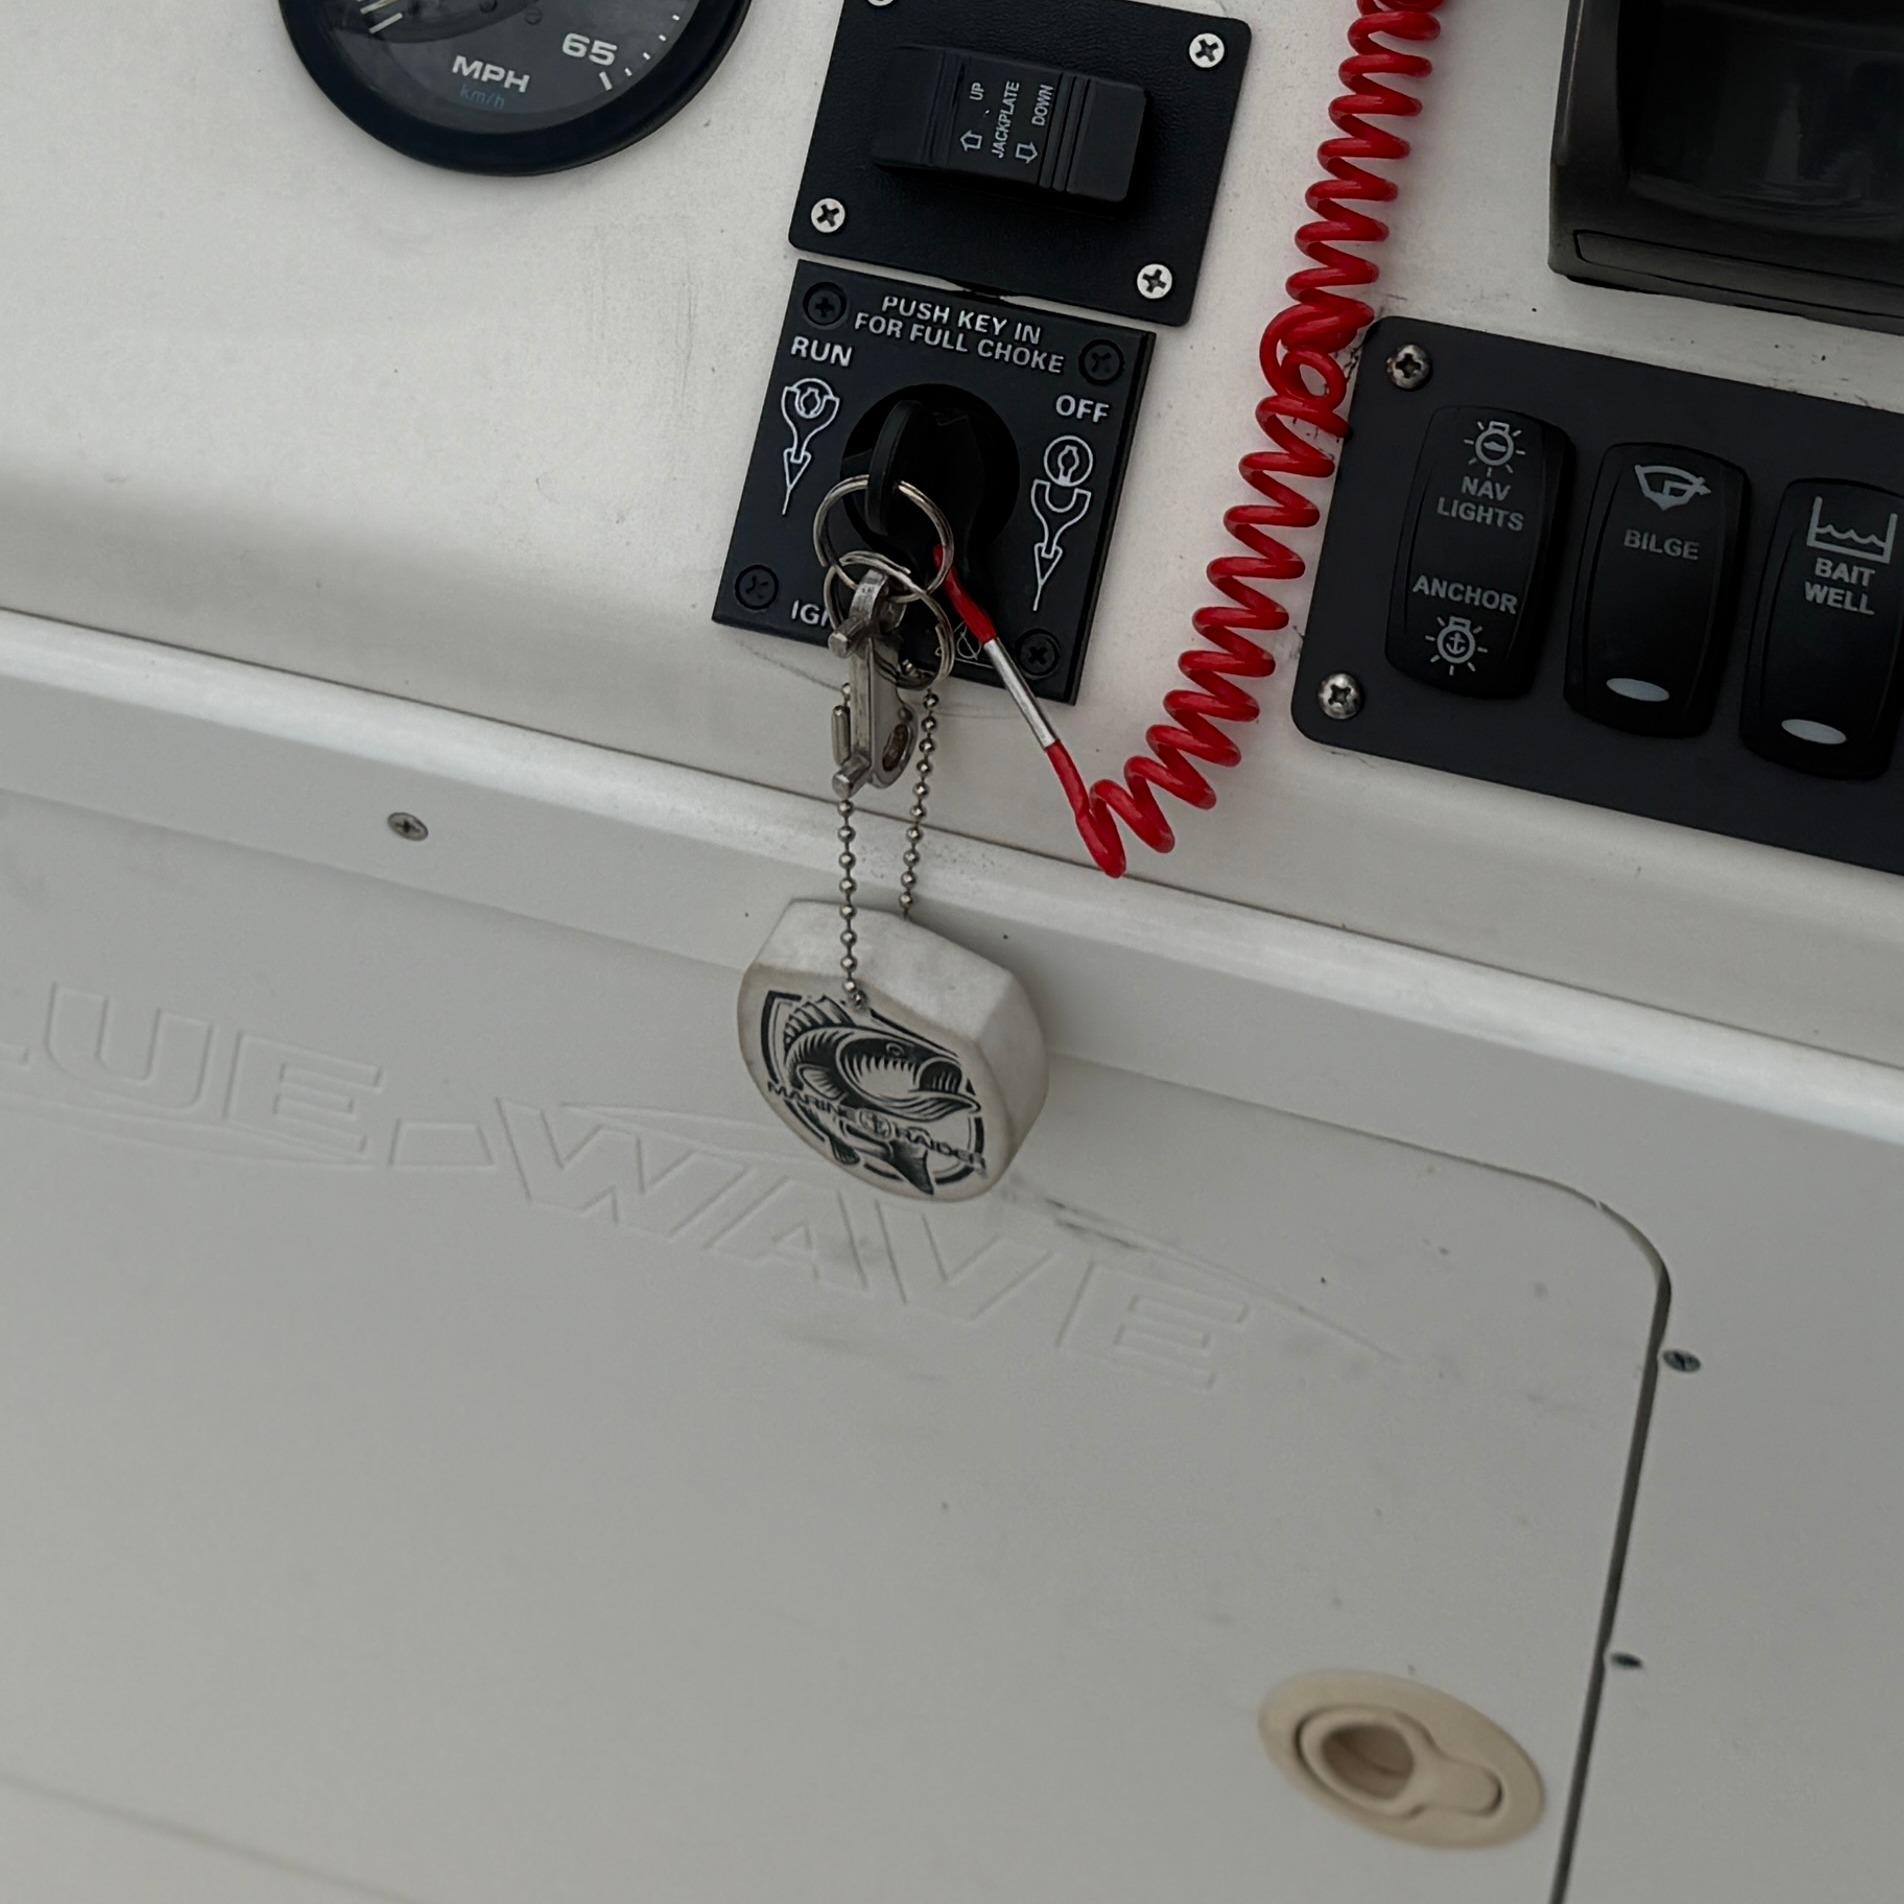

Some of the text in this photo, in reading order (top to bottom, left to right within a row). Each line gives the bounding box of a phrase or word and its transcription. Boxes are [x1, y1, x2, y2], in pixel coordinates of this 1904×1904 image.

[562, 31, 619, 67] 65
[452, 55, 531, 93] MPH
[969, 81, 985, 101] UP
[459, 84, 506, 110] km/h
[1031, 83, 1055, 127] DOWN
[991, 80, 1021, 159] JACKPLATE
[881, 295, 1042, 345] PUSH KEY IN
[790, 335, 853, 367] RUN
[854, 311, 1065, 375] FOR FULL CHOKE
[1055, 394, 1110, 425] OFF
[1461, 474, 1511, 504] NAV
[1436, 500, 1525, 533] LIGHTS
[1622, 527, 1700, 561] BILGE
[1813, 557, 1876, 588] BAIT
[1411, 573, 1519, 615] ANCHOR
[1803, 581, 1876, 618] WELL
[768, 1080, 857, 1119] MARINE
[496, 1096, 1250, 1392] WAVE
